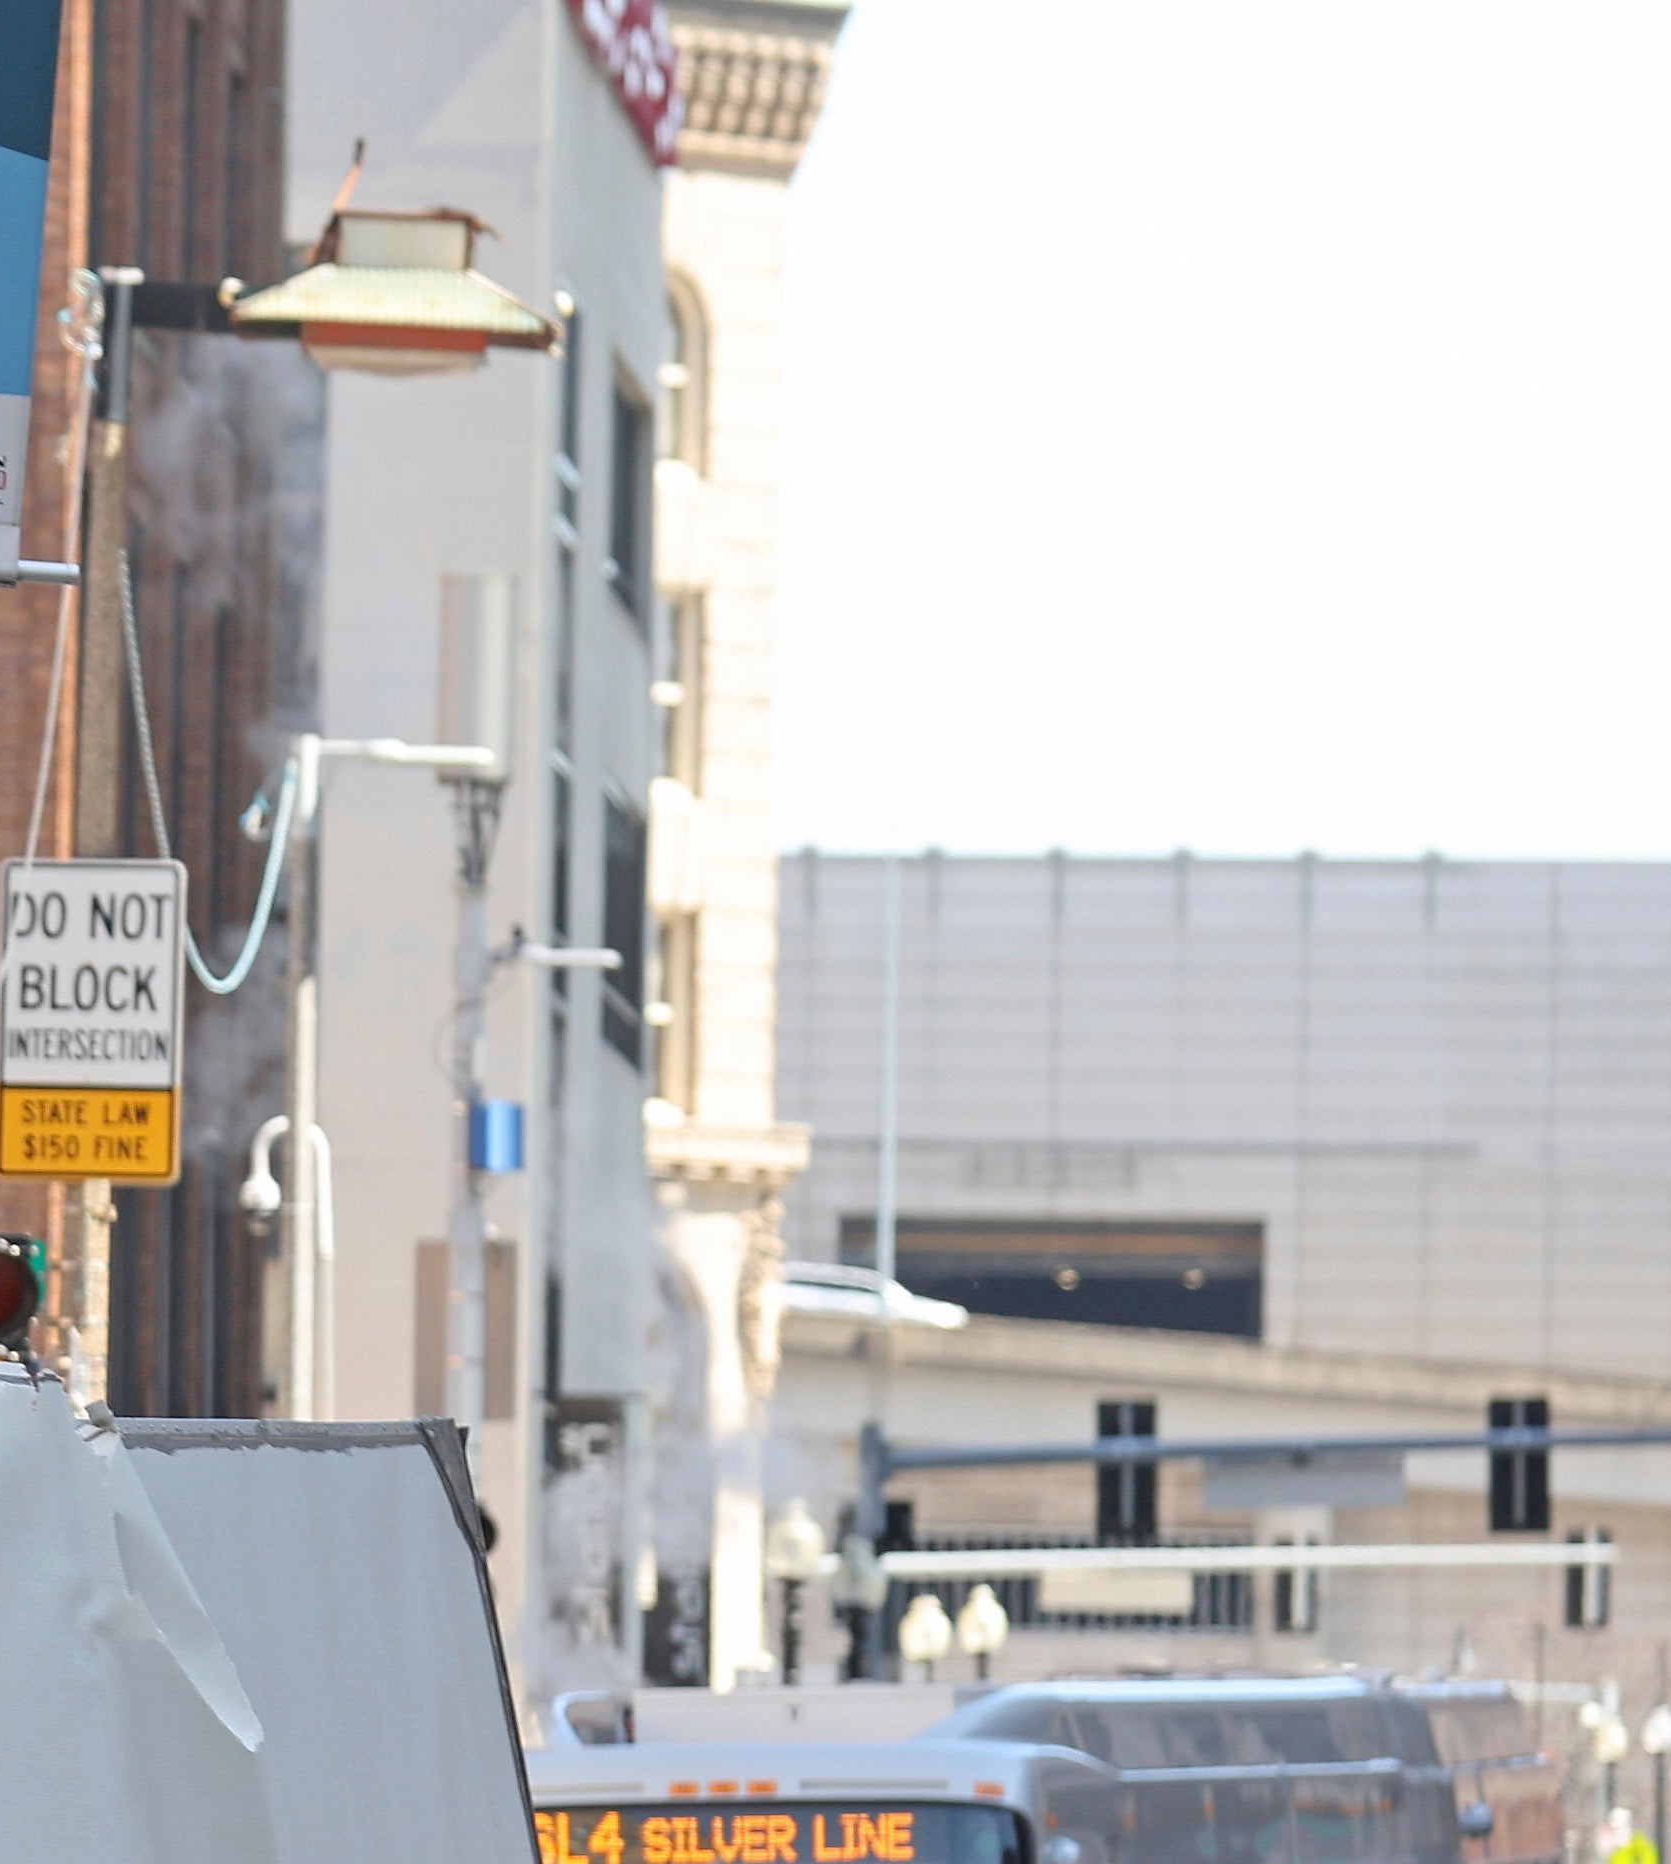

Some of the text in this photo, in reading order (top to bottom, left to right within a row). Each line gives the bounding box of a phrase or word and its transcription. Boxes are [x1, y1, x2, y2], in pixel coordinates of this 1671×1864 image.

[89, 891, 174, 941] NOT
[19, 963, 157, 1012] BLOCK
[8, 1027, 170, 1062] INTERSECTION
[20, 1099, 150, 1126] STATE LAW
[24, 1132, 149, 1162] $150 FINE
[812, 1811, 916, 1864] LINE
